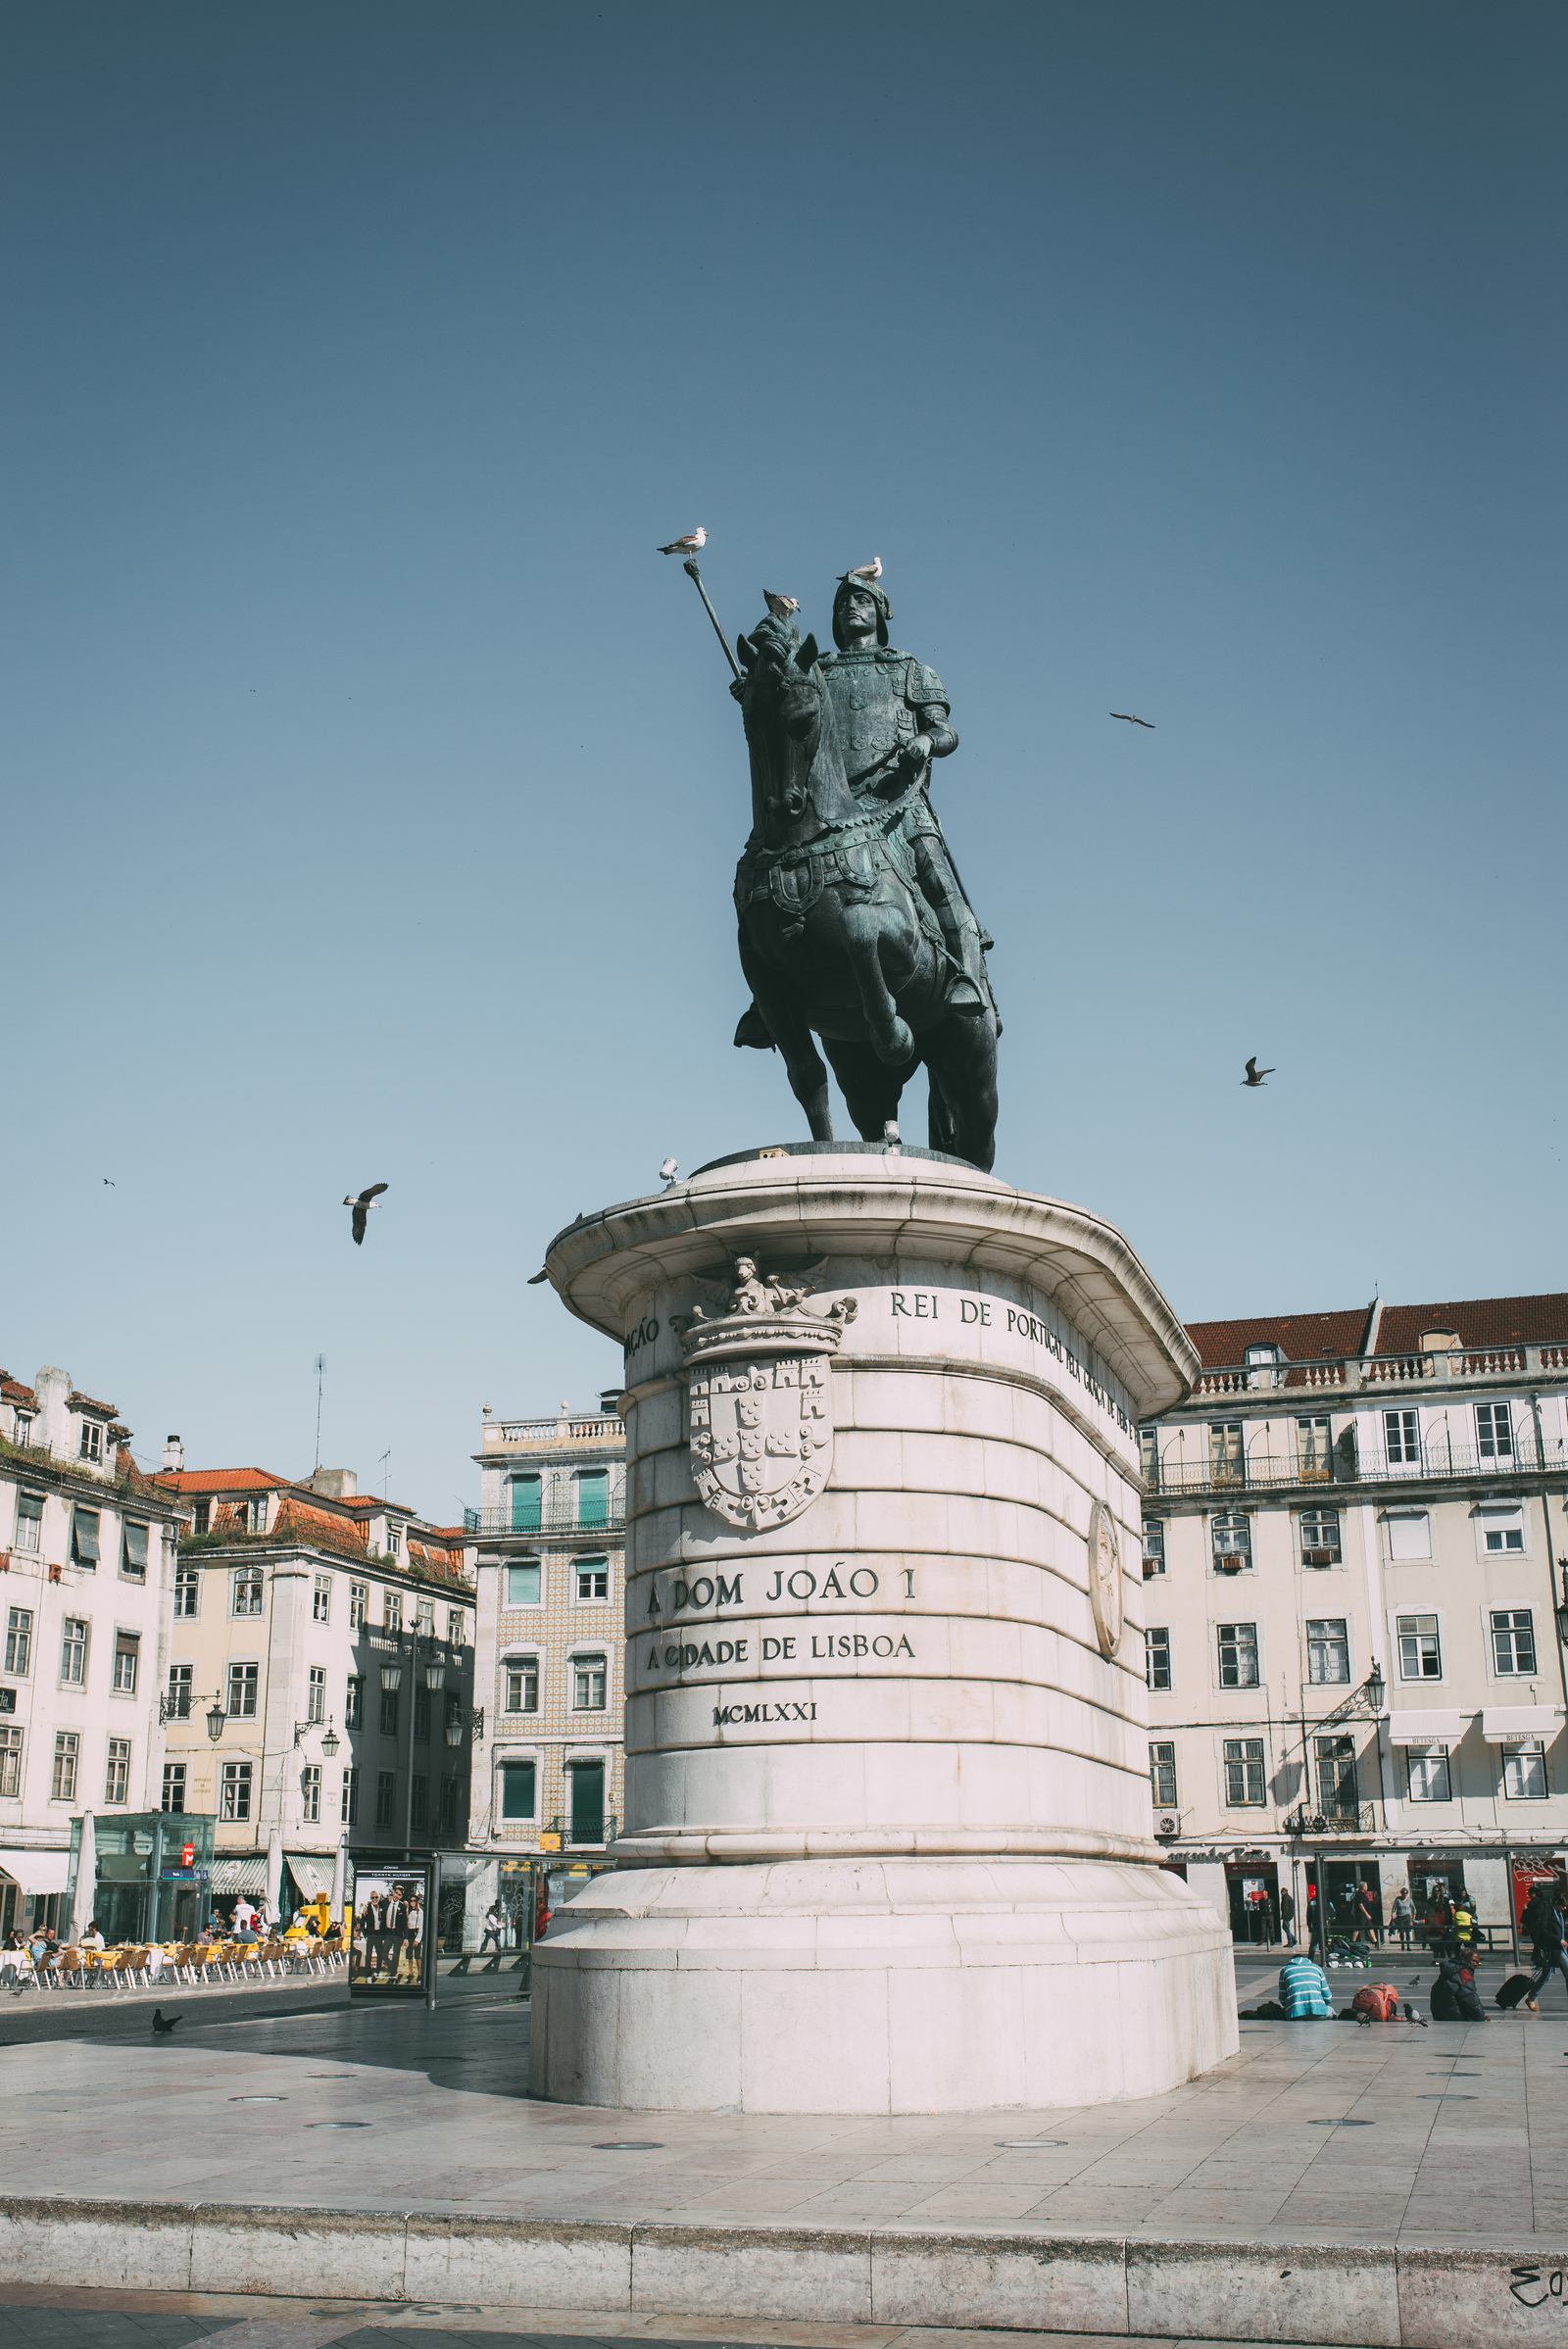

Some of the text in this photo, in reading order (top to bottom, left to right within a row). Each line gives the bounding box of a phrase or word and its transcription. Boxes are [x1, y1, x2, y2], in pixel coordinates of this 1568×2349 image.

[891, 1292, 939, 1319] REI
[959, 1298, 992, 1327] DE
[1006, 1308, 1063, 1363] PORTUGAL
[647, 1561, 916, 1614] A DOM JOÃO I
[647, 1633, 916, 1670] A CIDADE DE LISBOA
[712, 1702, 817, 1727] MCMLXXI
